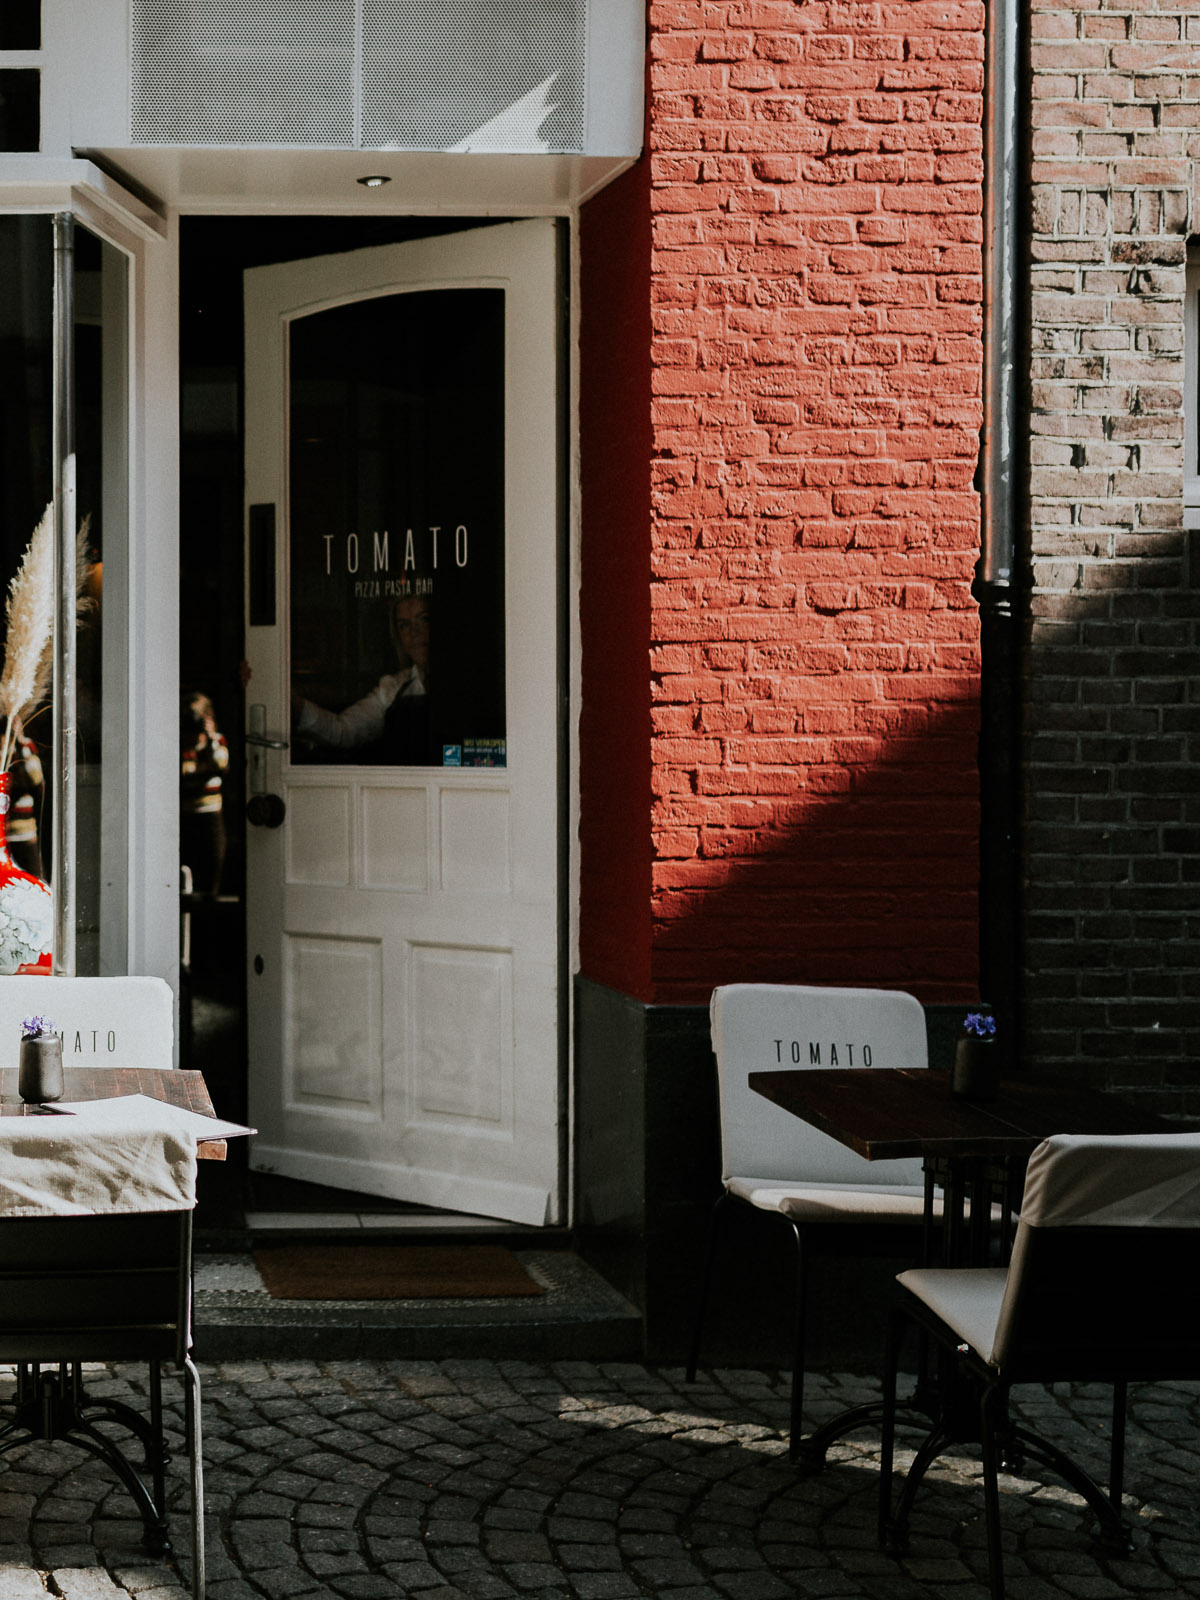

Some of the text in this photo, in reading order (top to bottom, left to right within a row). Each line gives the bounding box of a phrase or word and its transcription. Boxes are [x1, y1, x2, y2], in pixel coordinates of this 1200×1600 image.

[323, 525, 468, 575] TOMATO
[355, 578, 433, 598] PIZZA PASTA BAR
[774, 1039, 873, 1068] TOMATO
